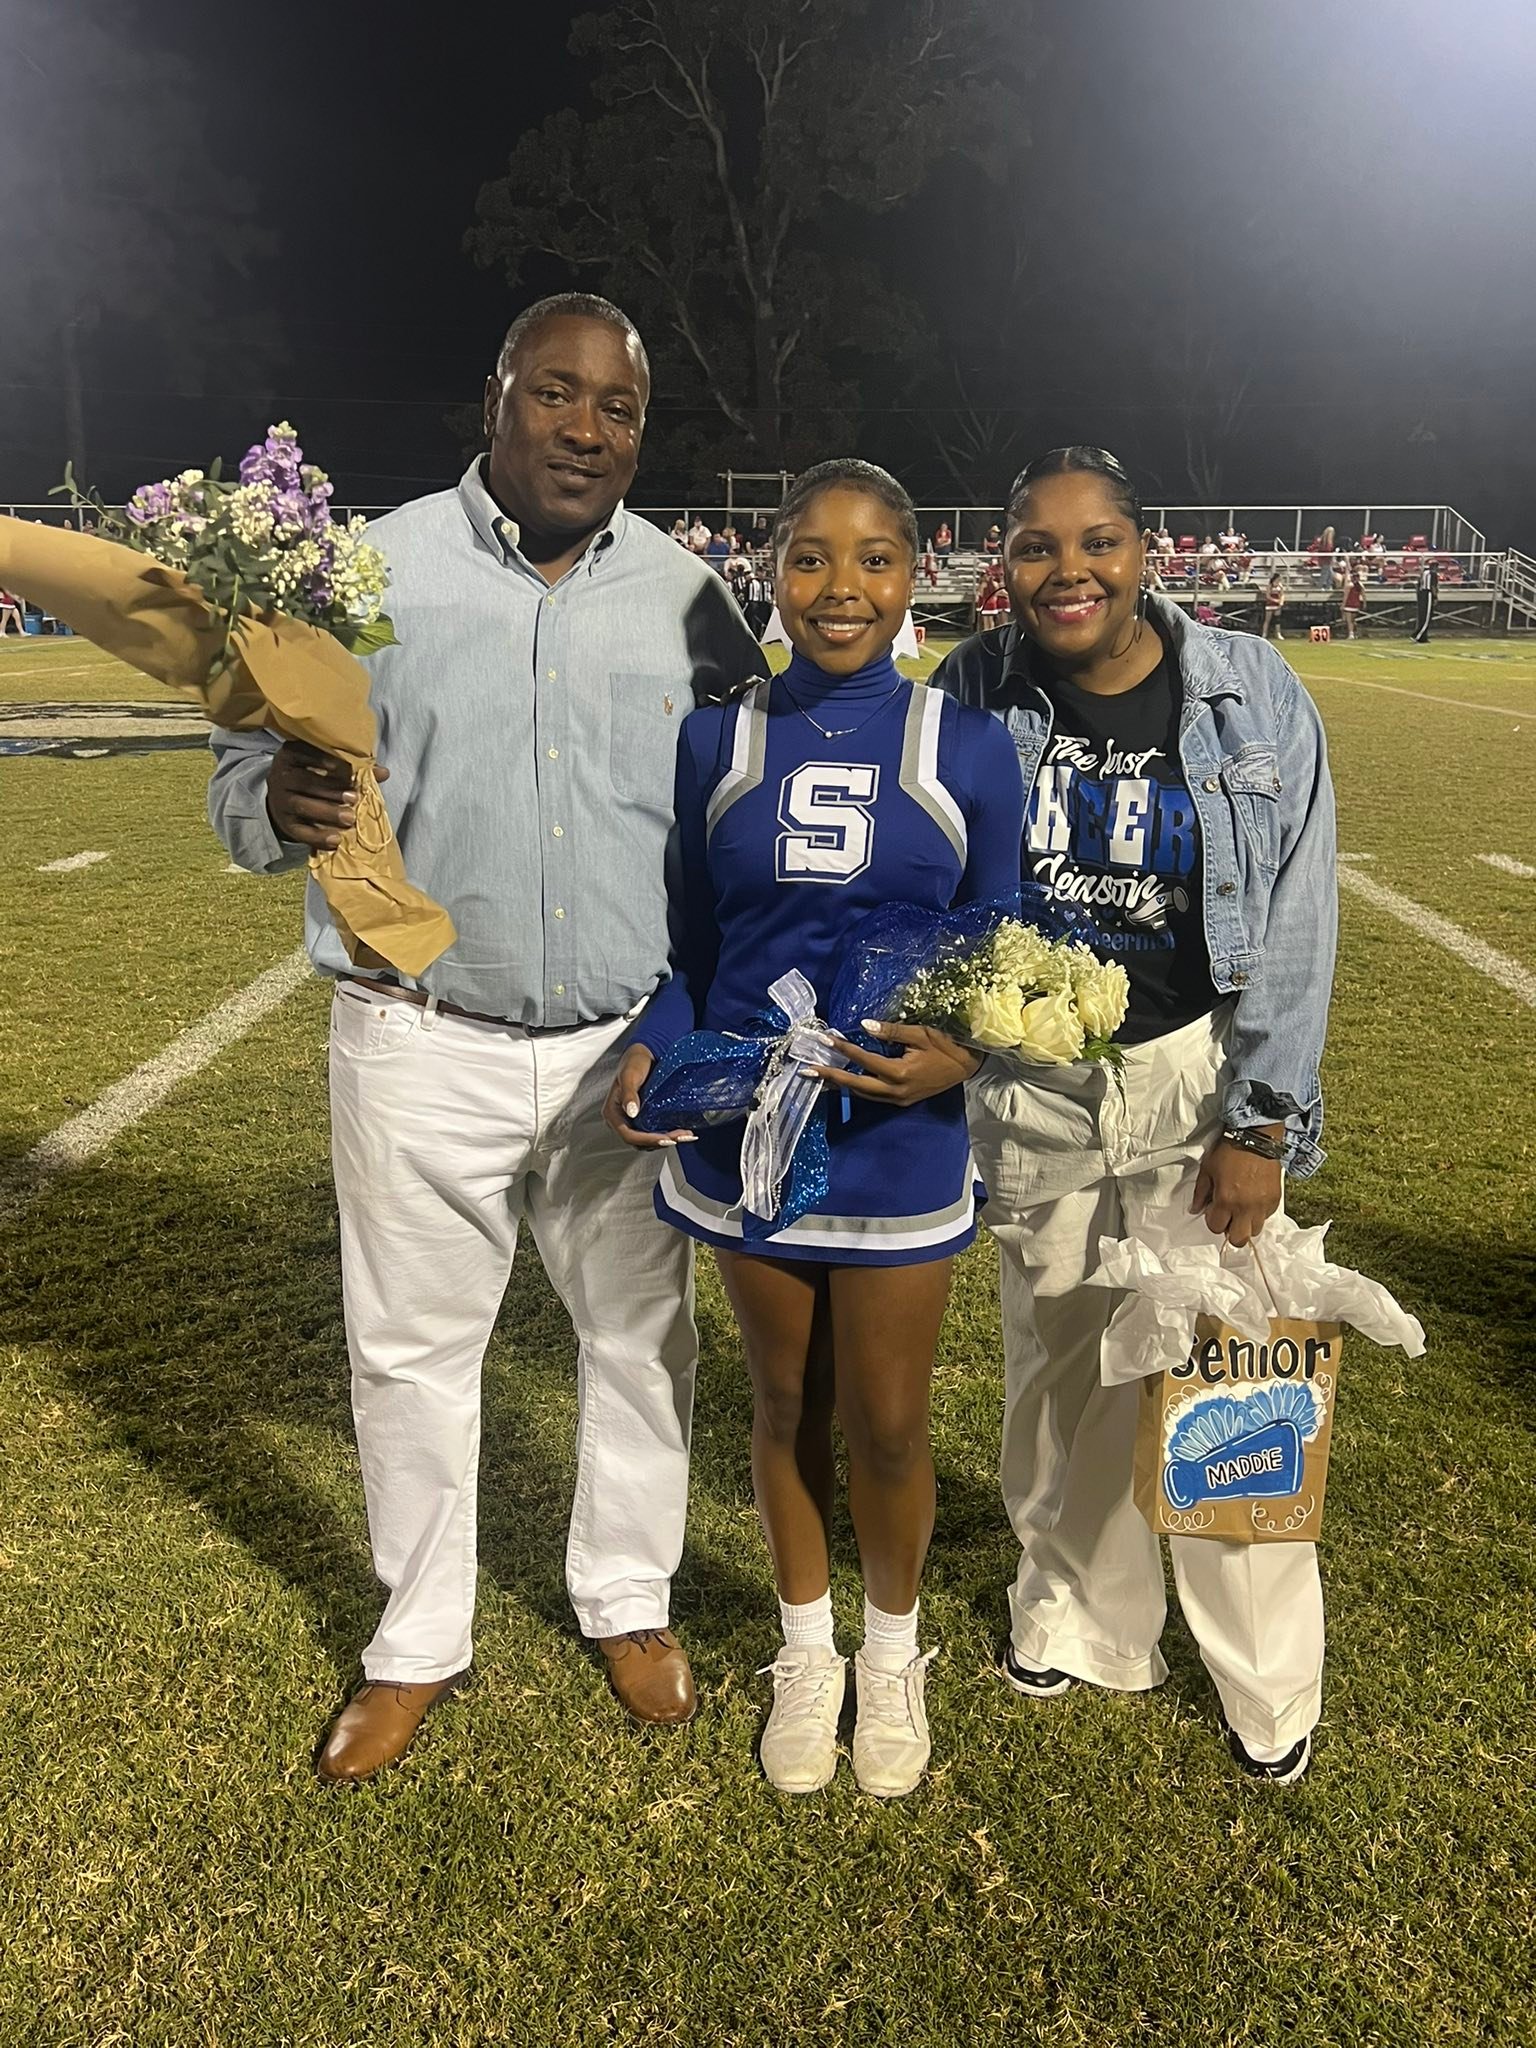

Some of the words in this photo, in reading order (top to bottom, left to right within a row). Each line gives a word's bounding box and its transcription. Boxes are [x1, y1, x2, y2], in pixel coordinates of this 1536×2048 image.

[1313, 628, 1328, 642] 30
[1046, 734, 1099, 772] The
[775, 761, 880, 885] S
[1026, 765, 1197, 876] HEER
[1032, 853, 1164, 909] Season
